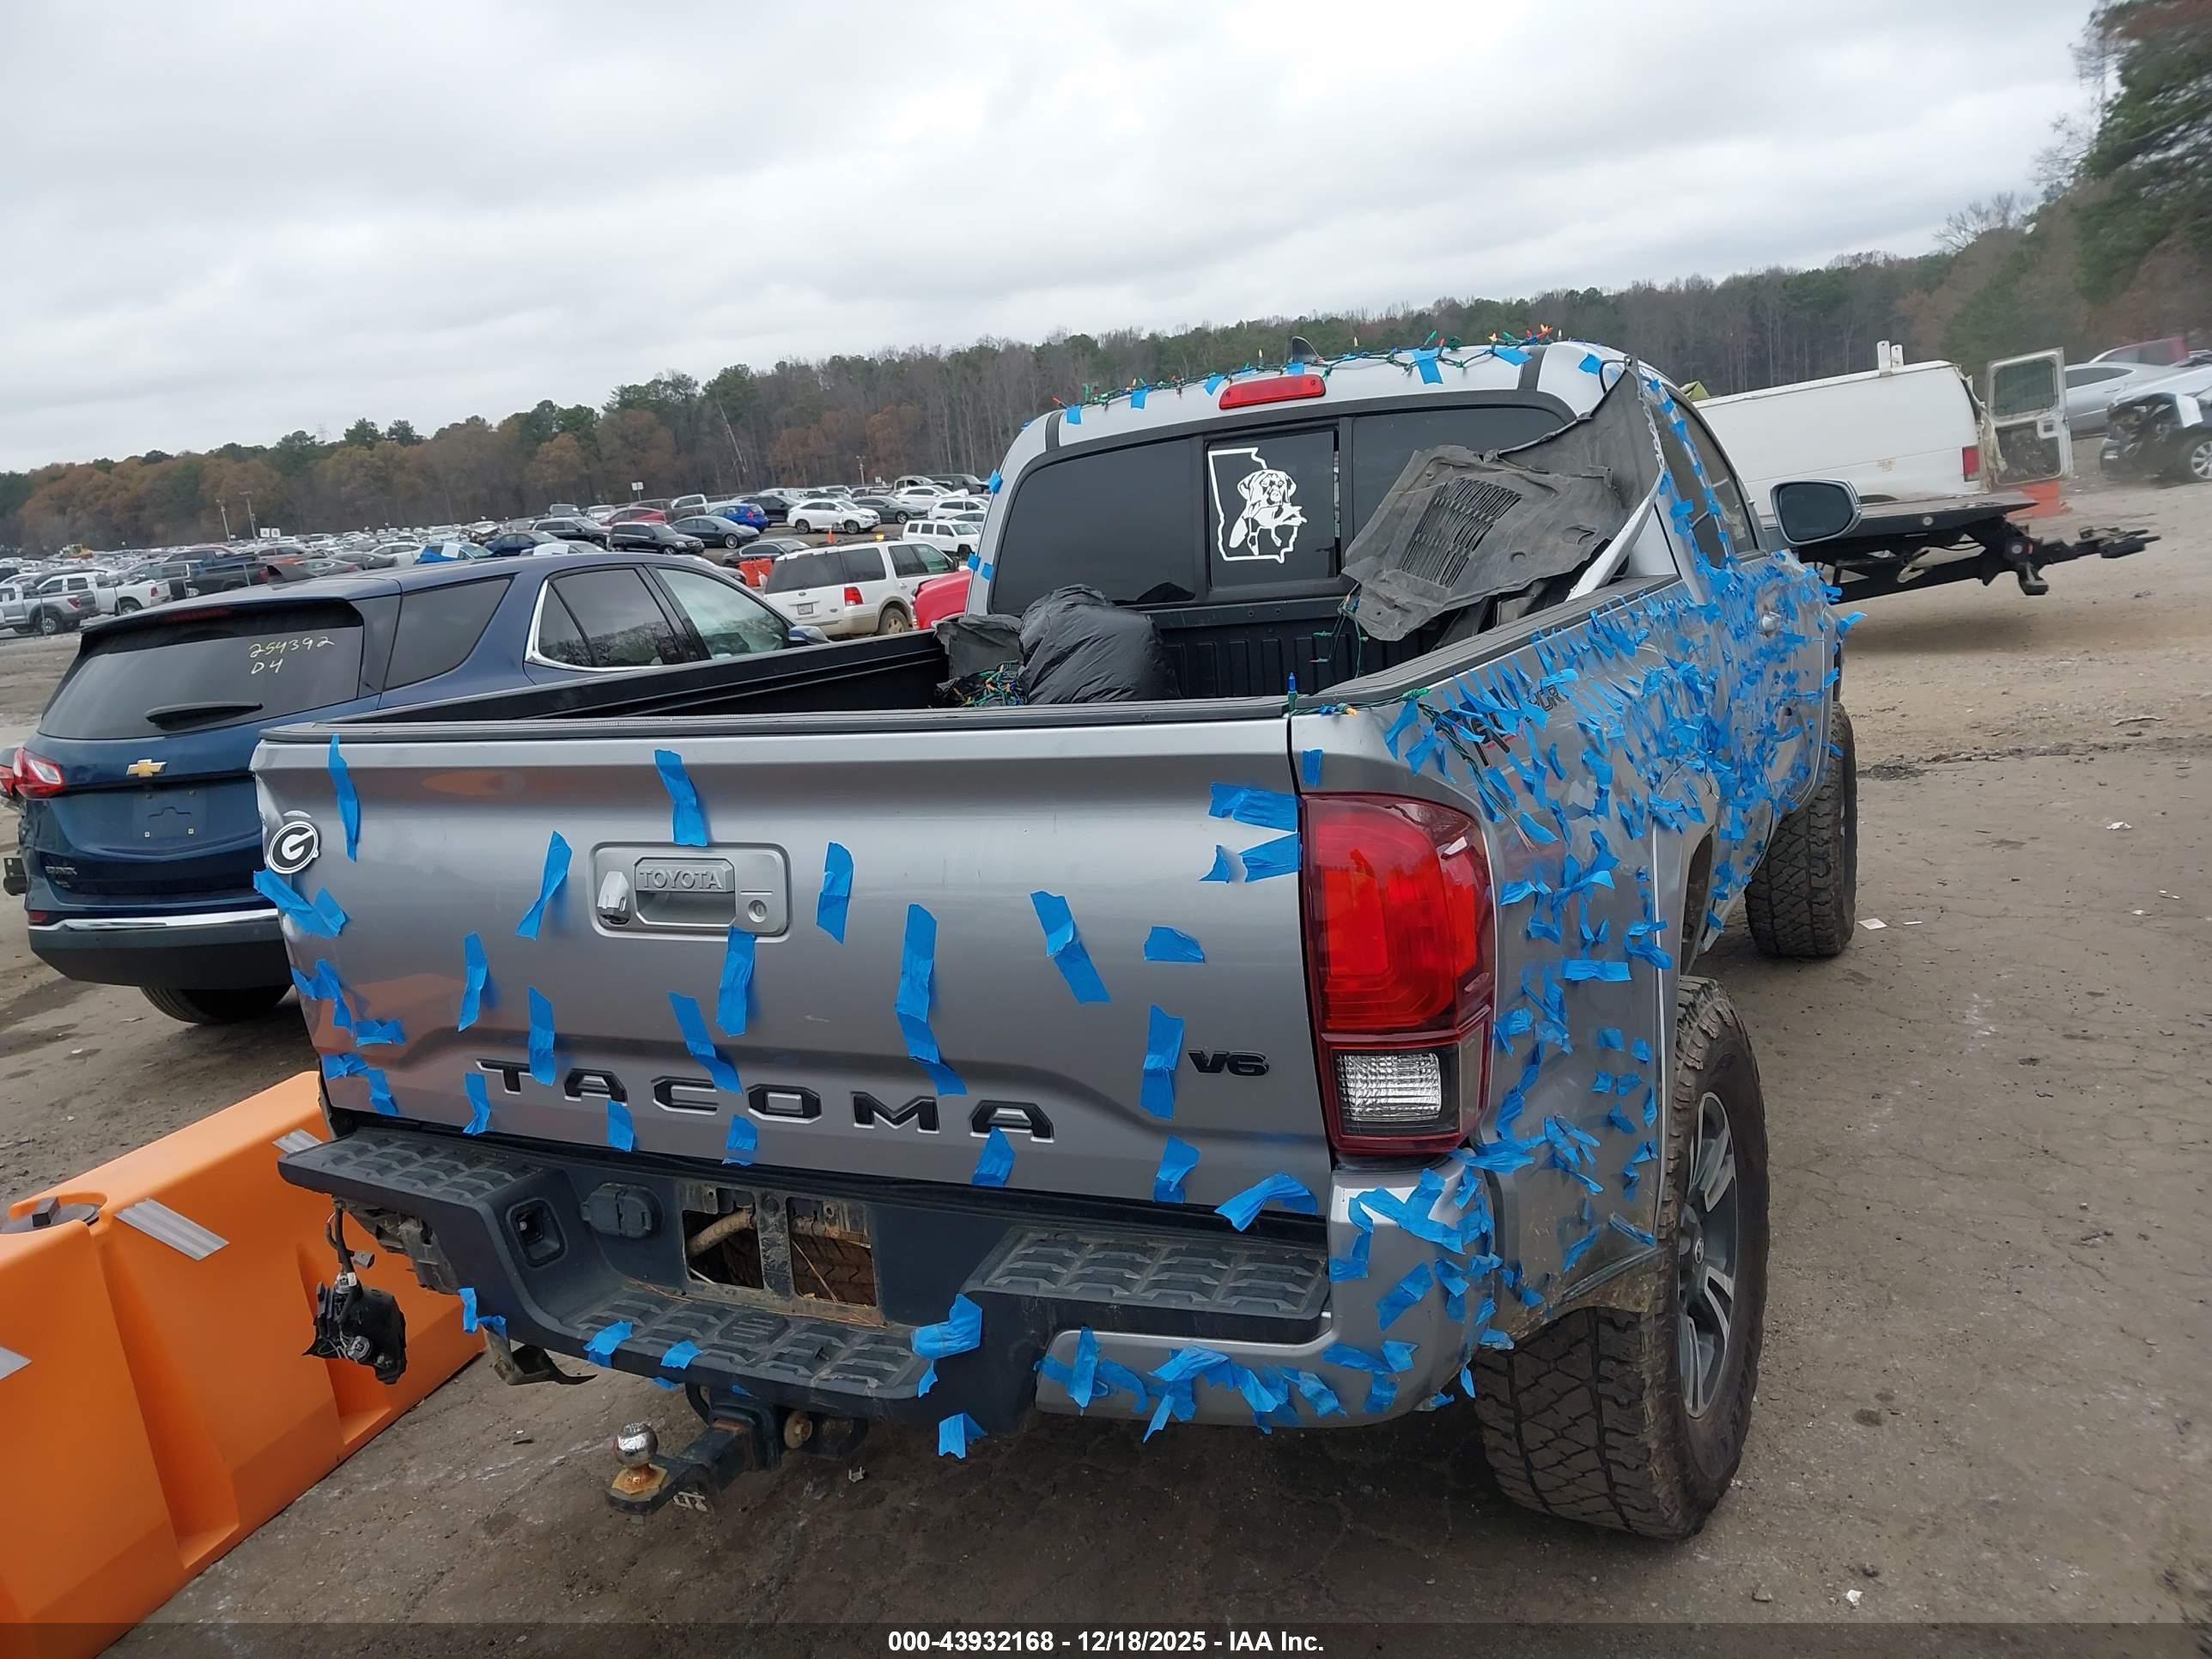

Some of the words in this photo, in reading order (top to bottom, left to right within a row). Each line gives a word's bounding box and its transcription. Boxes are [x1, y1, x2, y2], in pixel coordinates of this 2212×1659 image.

[248, 636, 335, 658] 254392
[639, 869, 724, 890] TOYOTA
[1188, 1049, 1270, 1077] V6
[475, 1058, 1055, 1144] TACOMA
